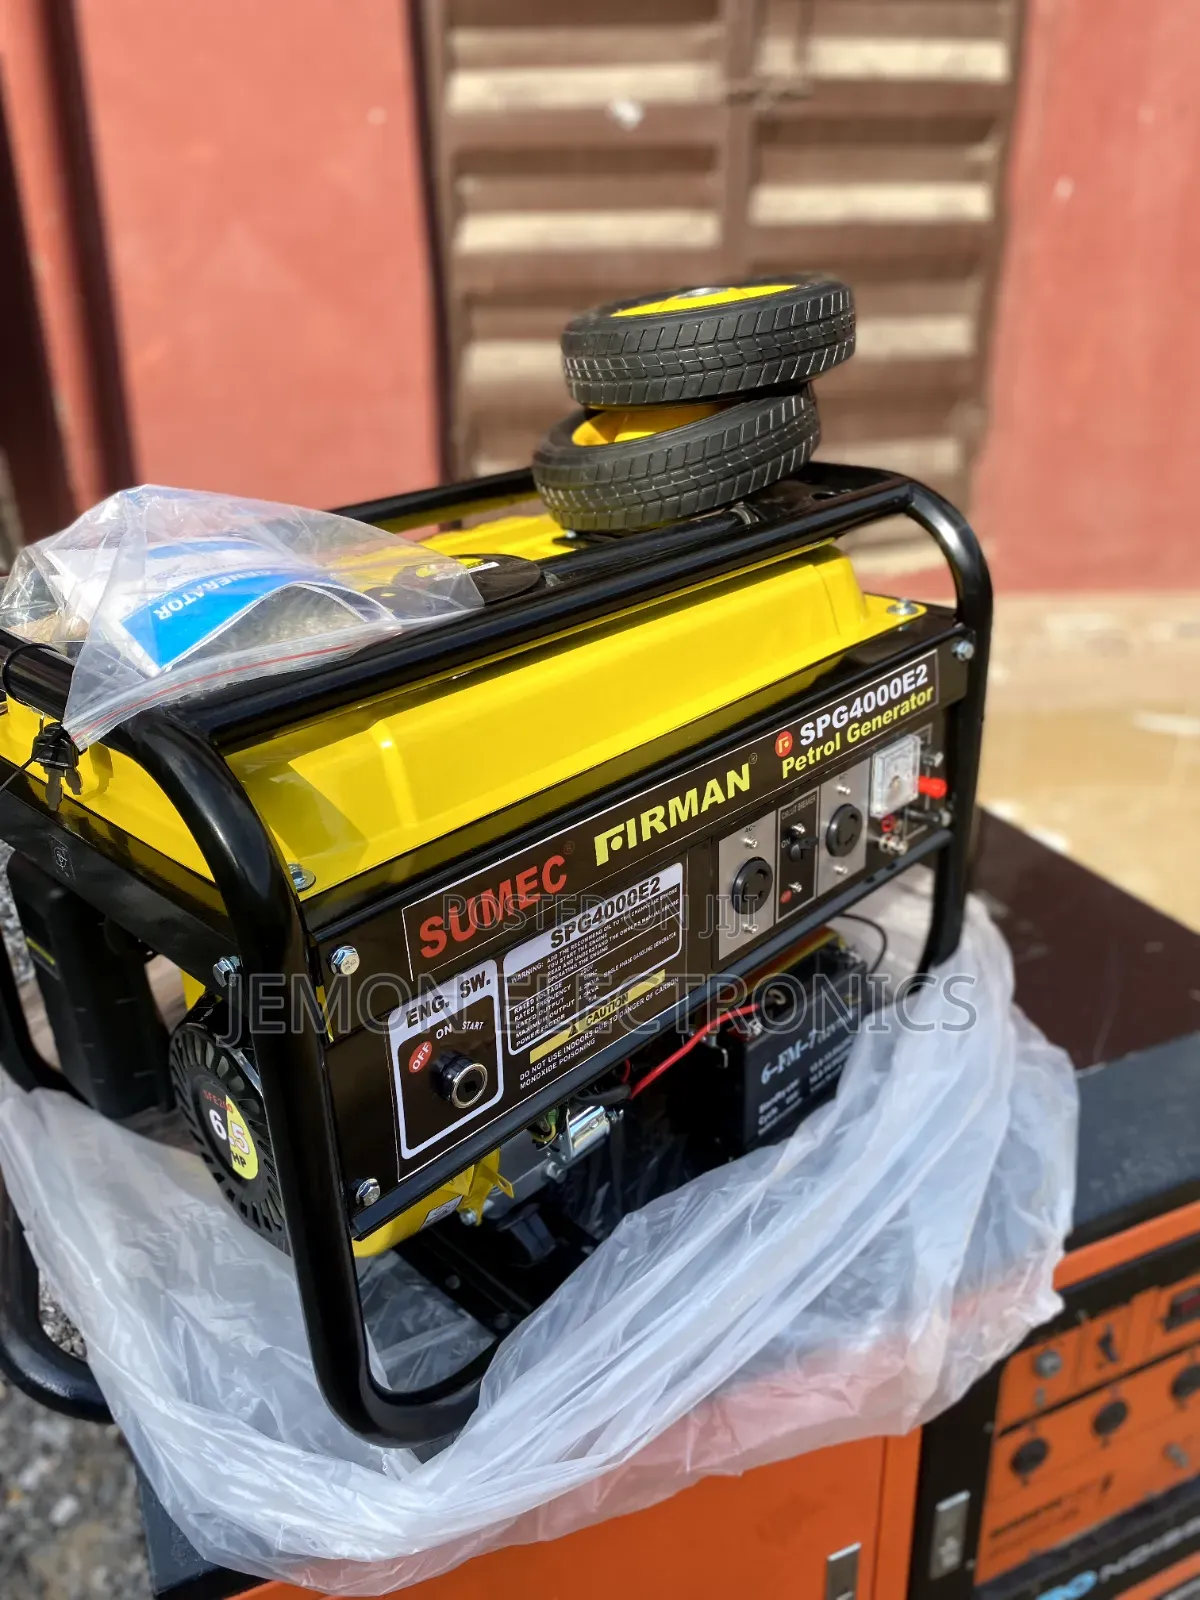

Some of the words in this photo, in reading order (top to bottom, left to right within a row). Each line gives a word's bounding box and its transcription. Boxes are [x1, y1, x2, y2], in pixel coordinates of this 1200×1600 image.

[800, 663, 929, 746] SPG4000E2
[782, 732, 841, 779] Petrol
[846, 686, 934, 743] Generator
[593, 763, 751, 867] FIRMAN
[419, 855, 567, 958] SUMEC
[550, 876, 661, 949] SPG4000E2
[511, 962, 544, 984] WARNING:
[547, 953, 558, 964] ADD
[559, 947, 569, 957] THE
[570, 928, 603, 950] RECOMMEND
[560, 951, 576, 964] START
[577, 944, 588, 954] THE
[563, 958, 574, 968] AND
[575, 938, 609, 960] UNDERSTAND
[579, 956, 589, 966] THE
[406, 994, 449, 1028] ENG.
[460, 970, 491, 999] SW.
[514, 998, 535, 1015] RATED
[514, 1006, 535, 1022] RATED
[515, 1013, 537, 1029] RATED
[538, 997, 565, 1016] OUTPUT
[586, 992, 630, 1026] CAUTION
[436, 1022, 453, 1039] ON
[461, 1020, 484, 1030] START
[515, 1015, 548, 1038] MAXIMUM
[549, 998, 575, 1018] OUTPUT
[516, 1028, 540, 1047] POWER
[541, 1013, 565, 1032] FACTOR
[519, 1070, 530, 1081] DO
[531, 1061, 547, 1075] NOT
[547, 1051, 563, 1065] USE
[563, 1031, 593, 1054] INDOORS
[608, 1014, 619, 1025] TO
[619, 998, 645, 1018] DANGER
[645, 991, 654, 1002] OF
[654, 977, 679, 996] CARBON
[412, 1042, 430, 1070] OFF
[519, 1062, 558, 1090] MONOXIDE
[558, 1037, 596, 1067] POISONING
